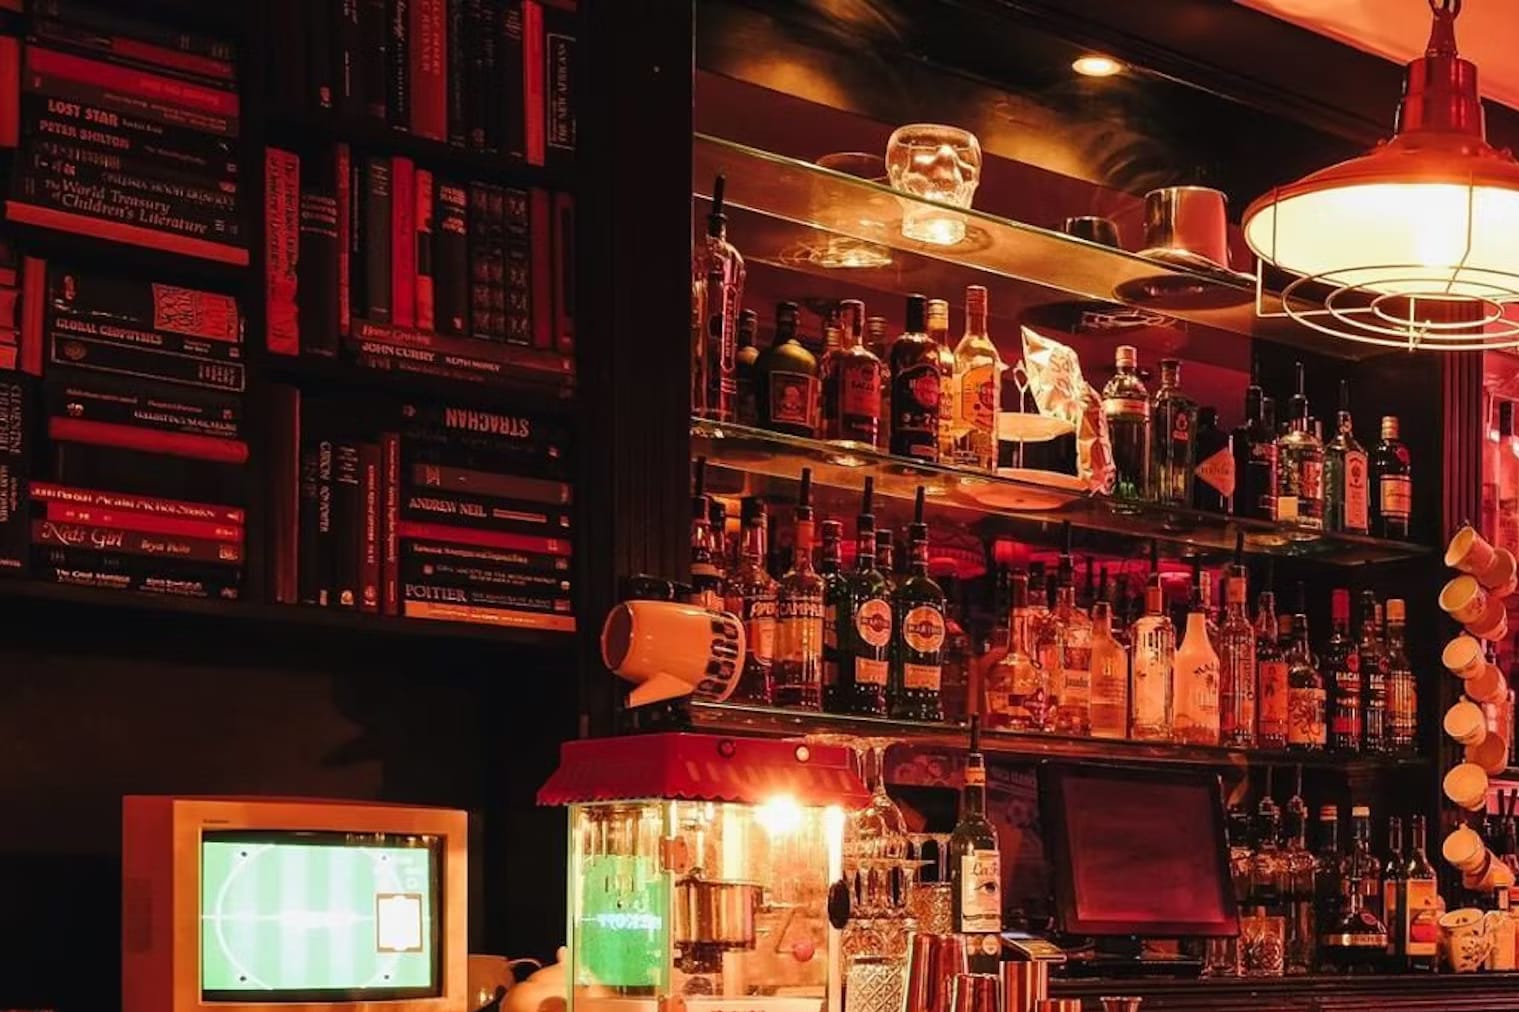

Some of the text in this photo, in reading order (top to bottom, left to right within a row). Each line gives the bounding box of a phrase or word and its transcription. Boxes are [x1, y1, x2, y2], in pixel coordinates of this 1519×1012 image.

[48, 99, 81, 119] LOST
[84, 107, 119, 128] STAR
[40, 119, 131, 150] PETER SHILTON
[62, 179, 105, 201] World
[110, 189, 171, 216] Treasury
[139, 211, 209, 235] Literature
[361, 342, 394, 358] JOHN
[445, 408, 530, 438] STRACHAN
[407, 497, 488, 519] ANDREW NEIL
[404, 584, 468, 604] POITIER
